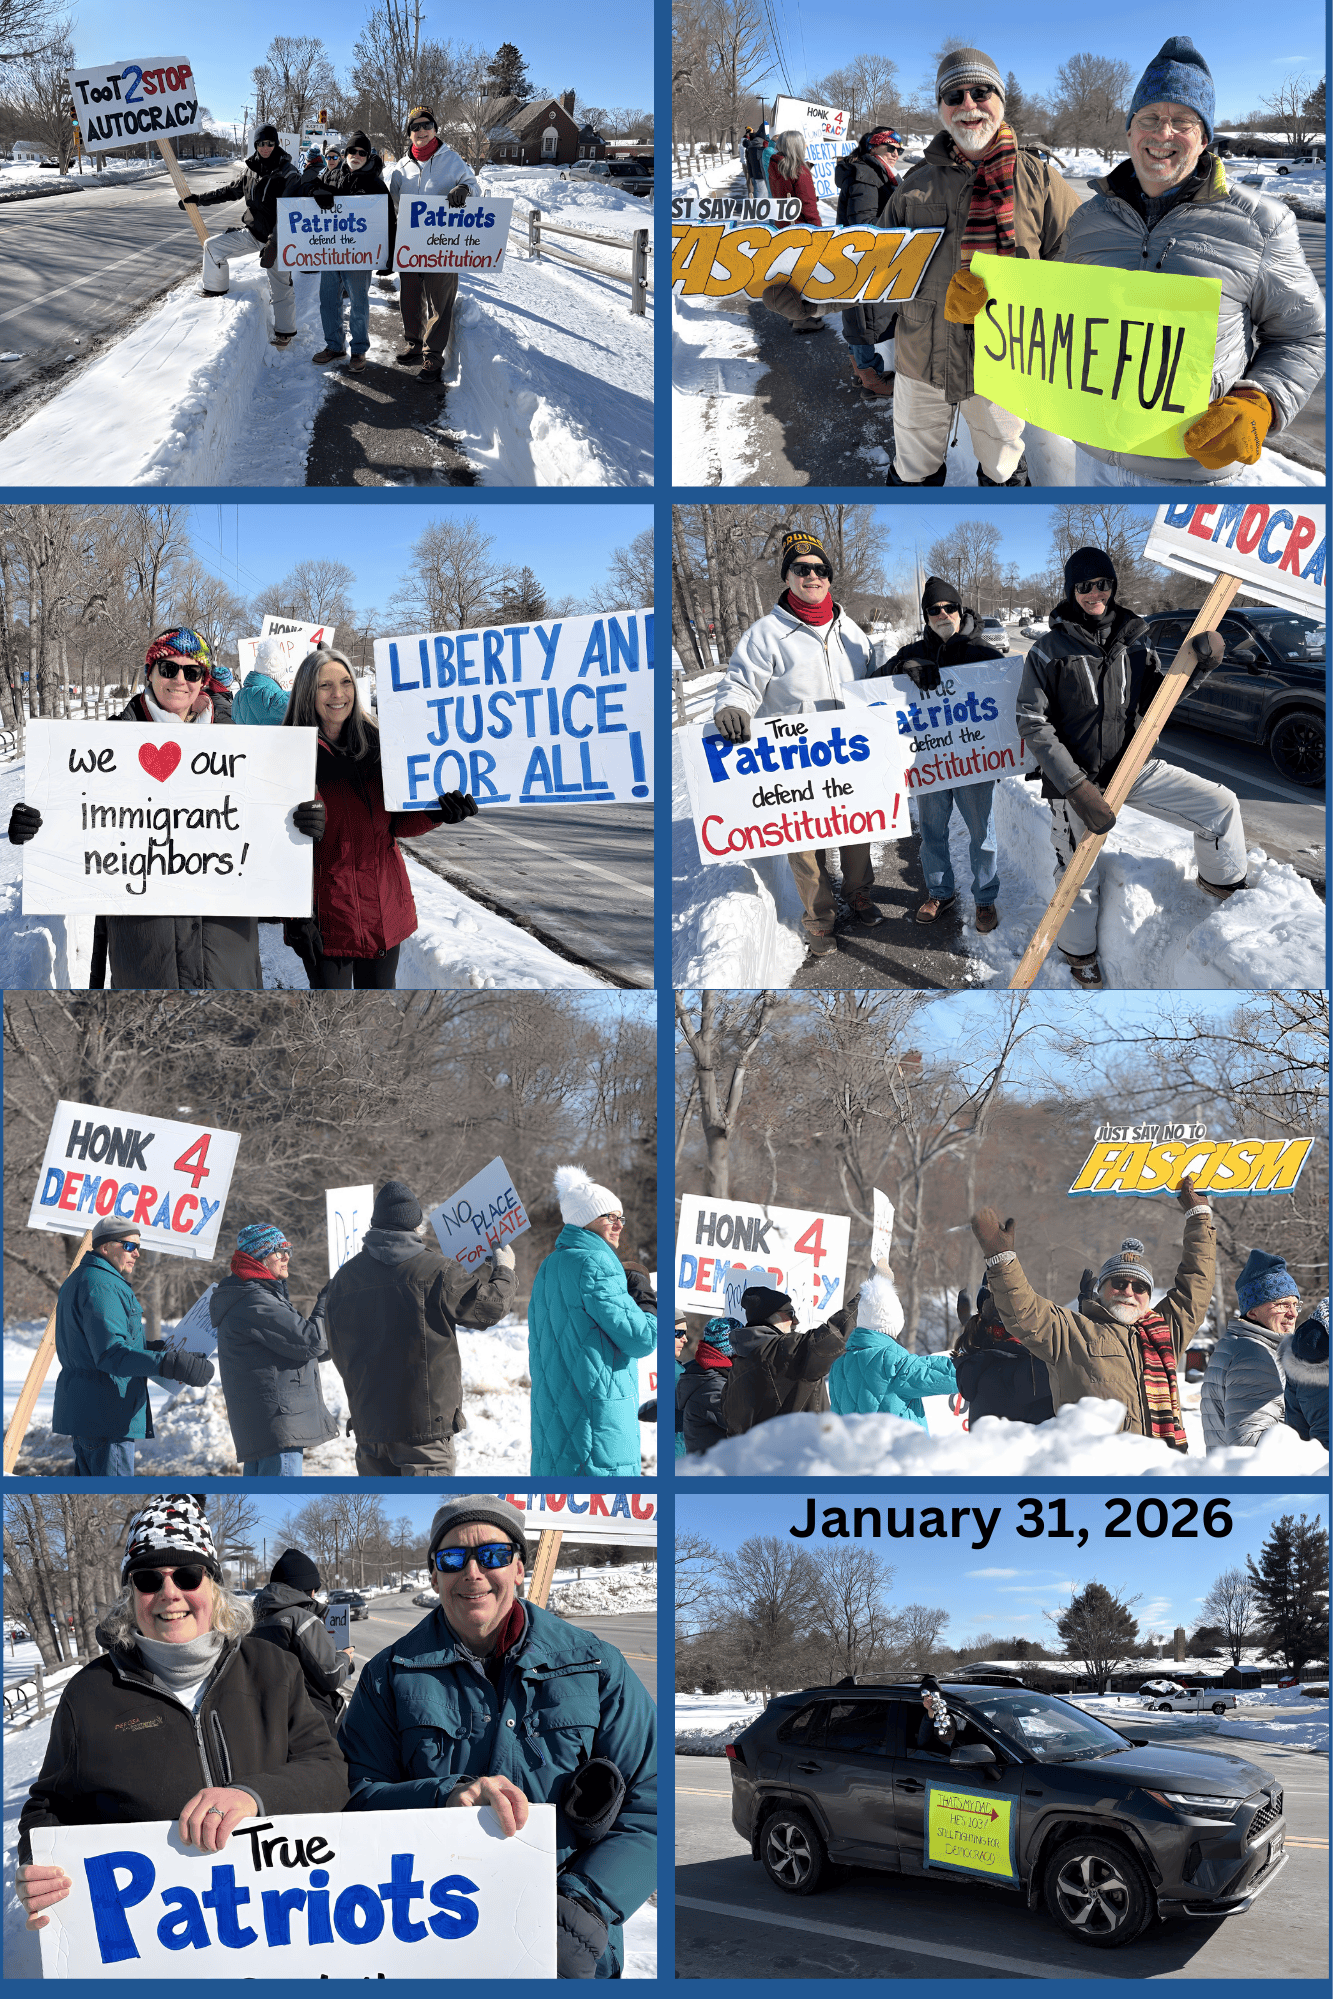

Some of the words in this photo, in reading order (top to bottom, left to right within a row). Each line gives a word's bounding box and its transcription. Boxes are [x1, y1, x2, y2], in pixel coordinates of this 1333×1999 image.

[141, 65, 193, 95] STOP
[88, 100, 198, 142] AUTOCRACY
[807, 107, 829, 121] HONK
[834, 112, 844, 125] 4
[821, 122, 846, 136] CRACY
[804, 143, 837, 161] IBERTY
[814, 180, 832, 196] OR
[289, 211, 367, 233] Patriots
[411, 201, 496, 228] Patriots
[672, 198, 693, 219] ST
[699, 198, 736, 219] SAY
[742, 200, 772, 221] NO
[777, 200, 801, 220] TO
[283, 244, 381, 267] Constitution!
[309, 235, 336, 245] defend
[340, 234, 356, 245] the
[397, 245, 502, 268] Constitution!
[427, 233, 460, 246] defend
[464, 234, 480, 246] the
[984, 298, 1186, 414] SHAMEFUL
[1164, 504, 1326, 586] EMOCRA
[309, 627, 325, 645] 4
[389, 623, 563, 692] LIBERTY
[427, 683, 628, 746] JUSTICE
[765, 718, 809, 739] True
[896, 692, 999, 734] atriots
[702, 727, 871, 783] Patriots
[910, 731, 953, 753] defend
[959, 727, 986, 744] the
[69, 748, 117, 773] we
[191, 751, 247, 778] our
[406, 749, 499, 800] FOR
[904, 738, 1025, 788] nstitution!
[752, 780, 814, 808] defend
[822, 777, 854, 799] the
[81, 792, 239, 847] immigrant
[702, 793, 901, 856] Constitution!
[85, 836, 250, 895] neighbors!
[1098, 1126, 1129, 1141] JUST
[1132, 1126, 1159, 1141] SAY
[1163, 1125, 1185, 1140] NO
[1189, 1125, 1206, 1139] TO
[65, 1120, 155, 1171] HONK
[174, 1133, 211, 1188] 4
[1072, 1140, 1312, 1190] FASCISM
[40, 1167, 220, 1236] DEMOCRACY
[442, 1201, 472, 1236] NO
[470, 1187, 518, 1236] PLACE
[456, 1245, 487, 1263] FOR
[485, 1206, 527, 1248] HATE
[696, 1211, 774, 1255] HONK
[794, 1218, 827, 1268] 4
[330, 1609, 347, 1627] and
[232, 1823, 336, 1872] True
[987, 1837, 1001, 1850] FOR
[84, 1851, 481, 1964] Patriots
